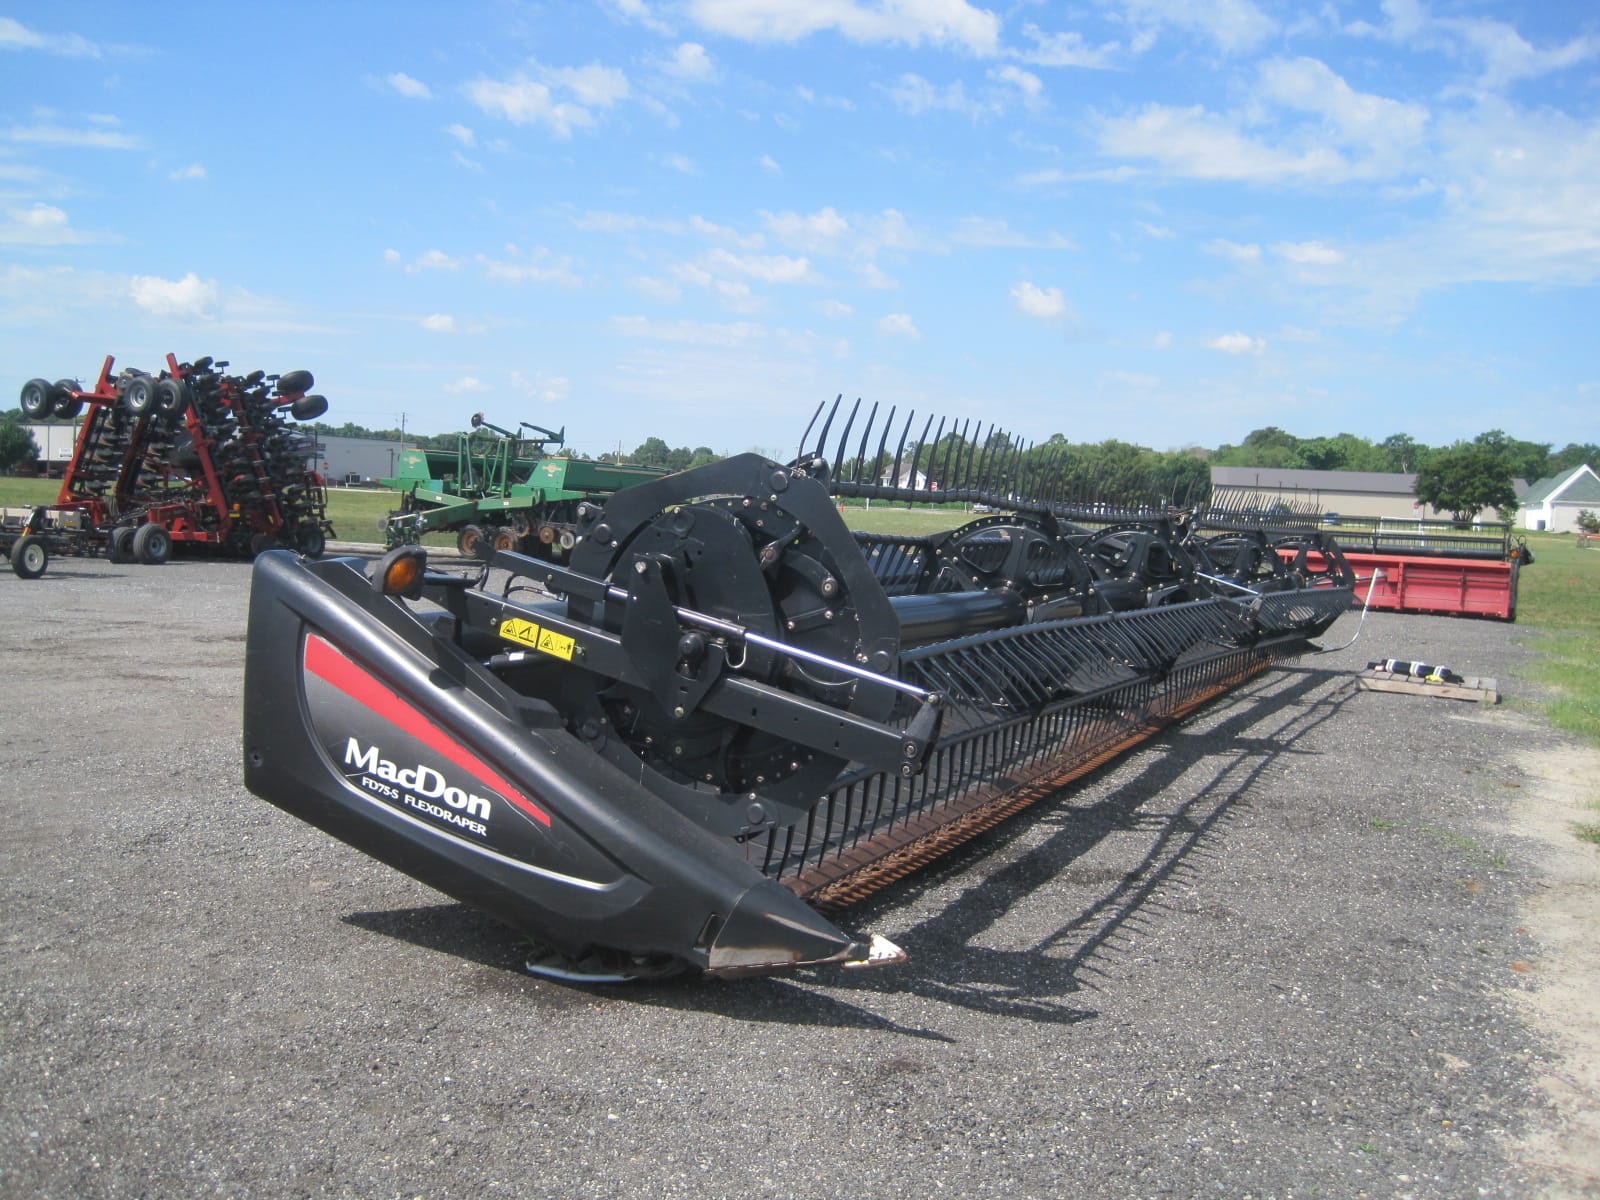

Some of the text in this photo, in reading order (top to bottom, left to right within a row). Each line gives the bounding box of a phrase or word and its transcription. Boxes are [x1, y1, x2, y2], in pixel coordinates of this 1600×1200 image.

[345, 738, 491, 820] MacDon
[363, 777, 487, 836] FD75-S FLEXDRAPER
